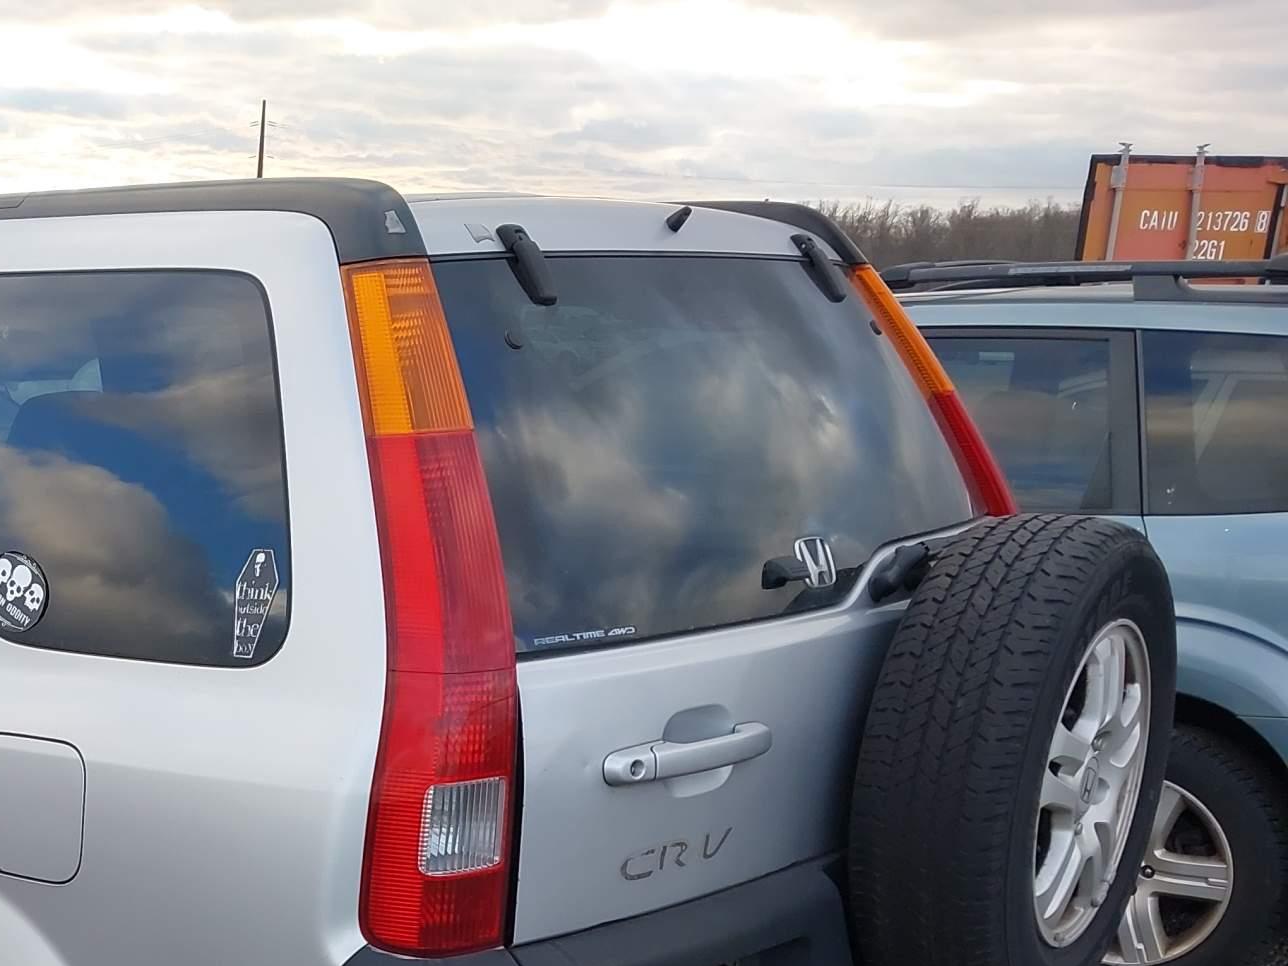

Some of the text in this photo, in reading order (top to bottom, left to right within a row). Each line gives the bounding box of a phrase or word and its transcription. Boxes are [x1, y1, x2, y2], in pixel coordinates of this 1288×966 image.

[1139, 210, 1270, 232] CAIU 213726 8
[1192, 240, 1225, 260] 22G1
[237, 580, 272, 600] think
[6, 603, 31, 627] ODDITY
[237, 617, 260, 637] the
